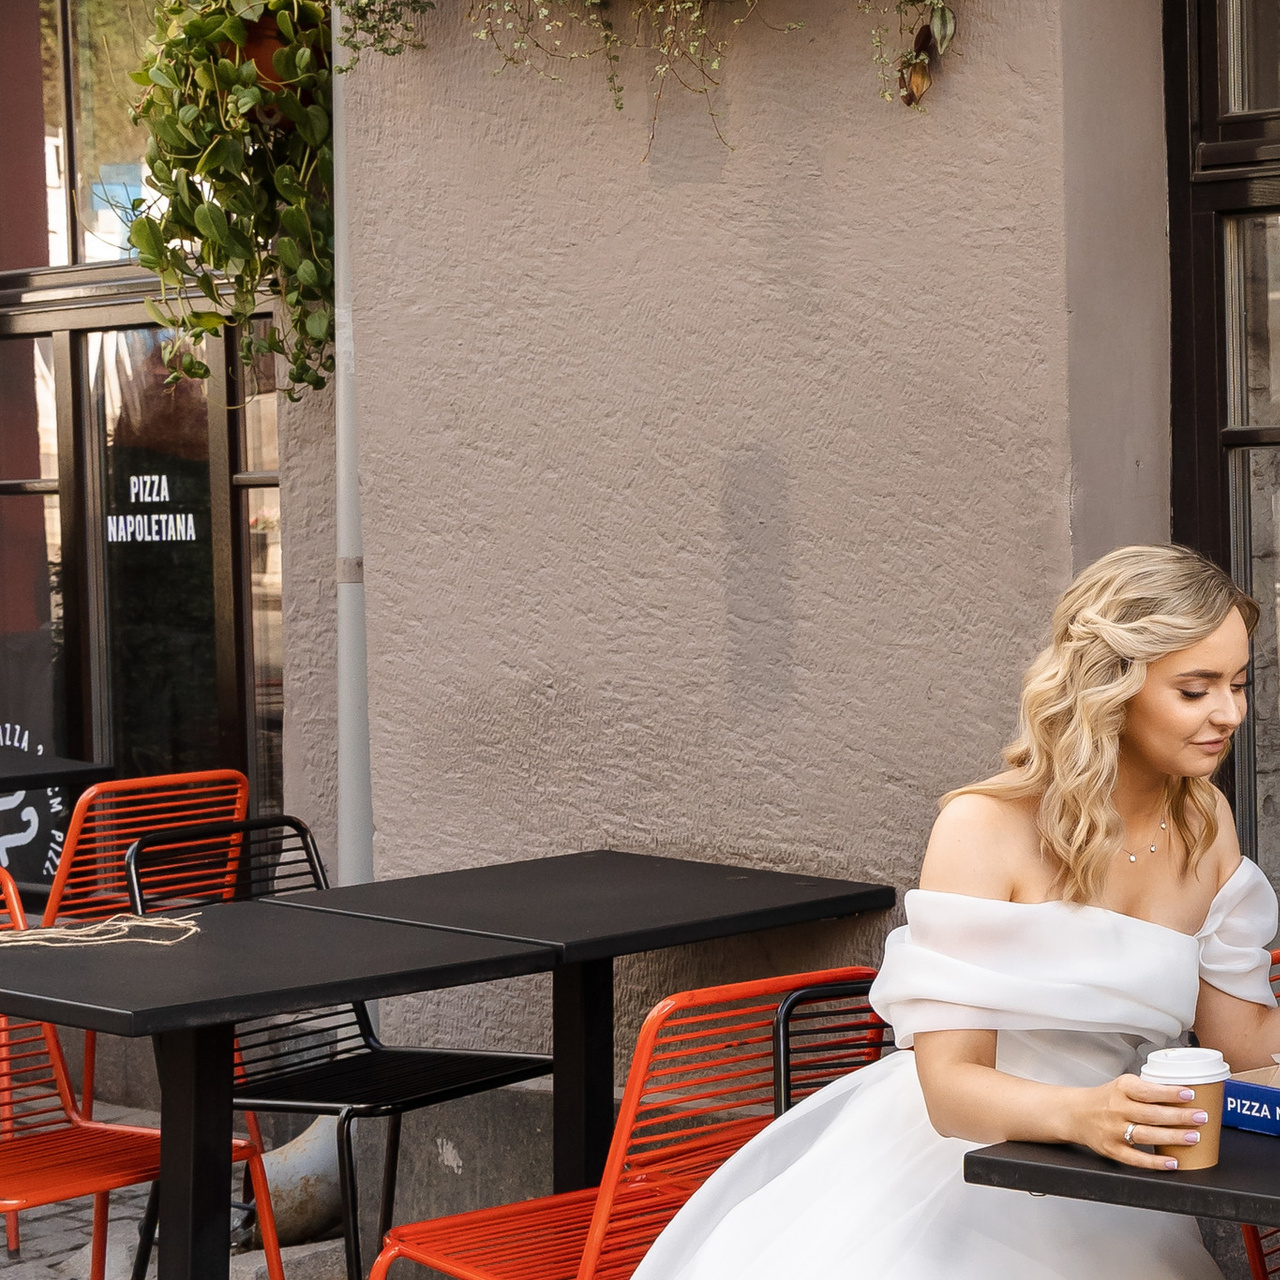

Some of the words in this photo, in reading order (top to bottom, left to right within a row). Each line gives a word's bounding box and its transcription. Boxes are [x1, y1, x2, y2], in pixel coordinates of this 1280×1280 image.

[129, 474, 170, 503] PIZZA
[107, 513, 196, 542] NAPOLETANA
[1226, 1096, 1272, 1120] PIZZA
